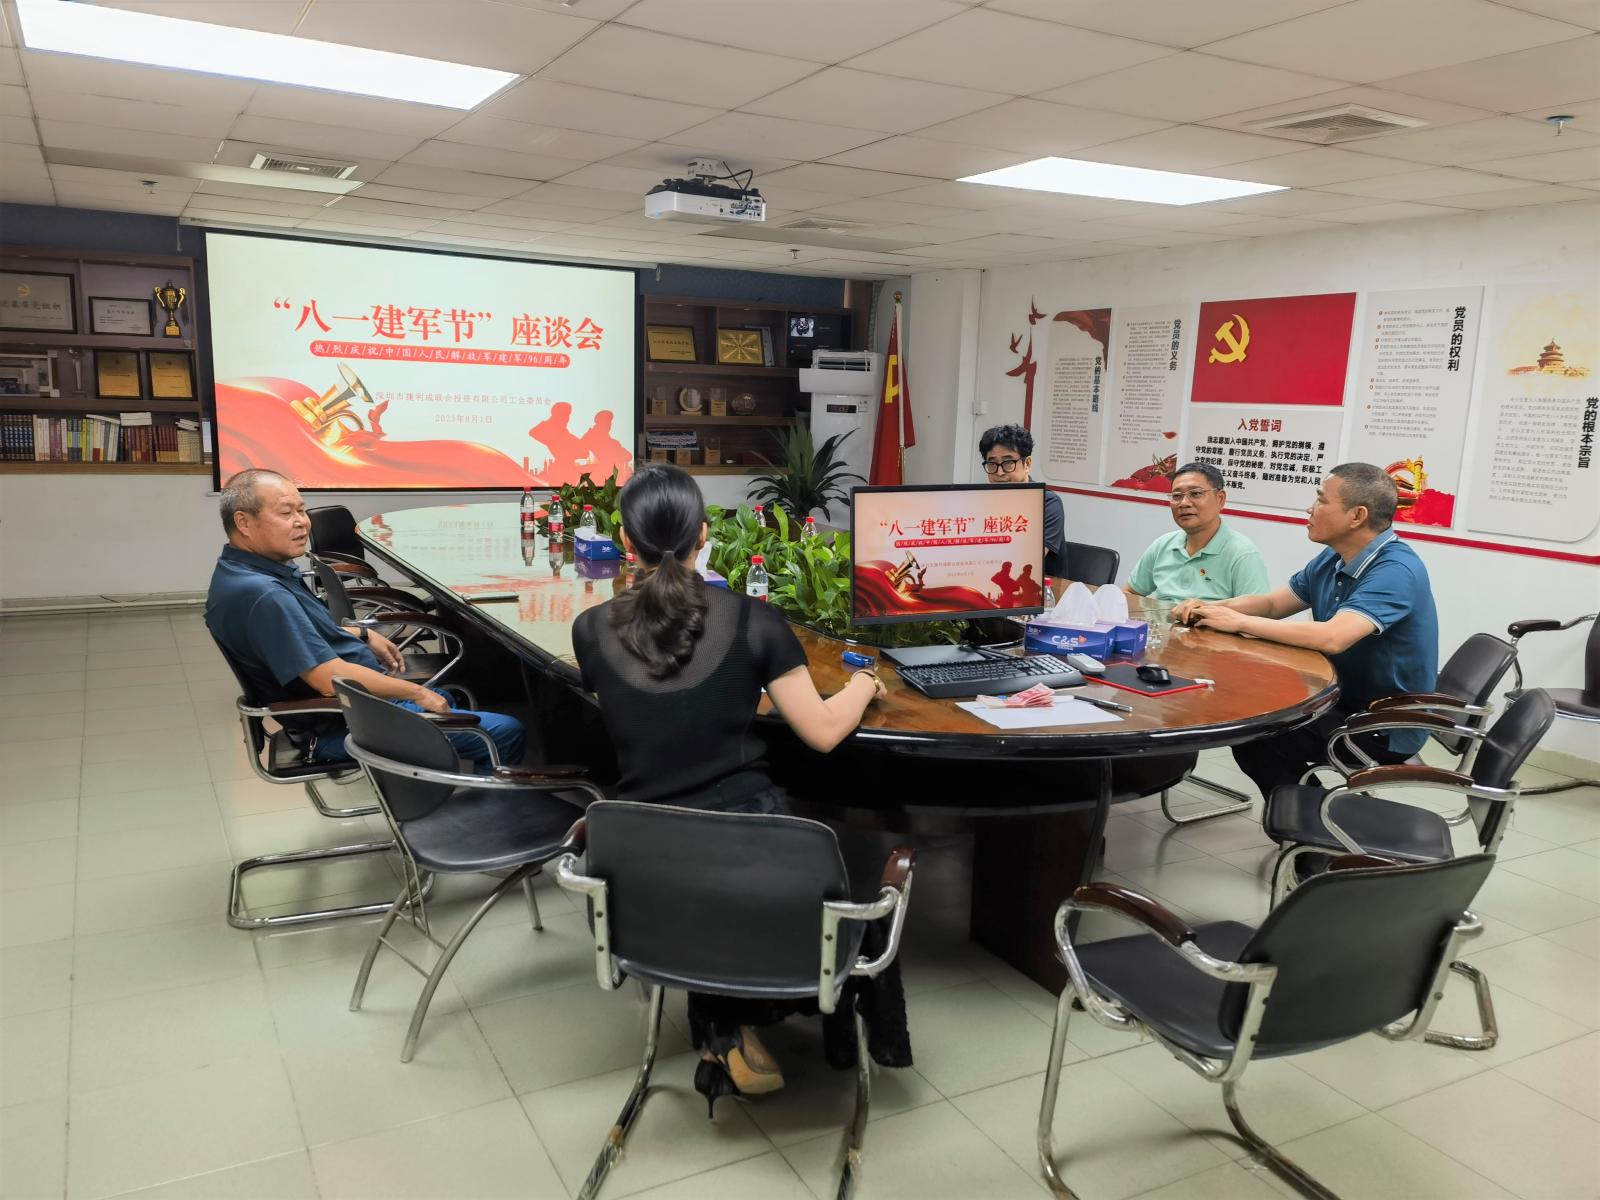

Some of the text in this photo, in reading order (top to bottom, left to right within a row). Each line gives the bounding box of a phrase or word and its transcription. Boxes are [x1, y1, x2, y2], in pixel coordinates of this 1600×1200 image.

[274, 297, 492, 343] “八一建军节”
[510, 313, 604, 350] 座谈会
[1447, 306, 1467, 372] 党员的权利
[1168, 319, 1182, 371] 党员的义务
[1237, 418, 1283, 433] 入党誓词
[1577, 396, 1600, 469] 党的根本宗旨
[1222, 469, 1322, 486] 主义奋斗终身，随时准备为党和人民
[880, 515, 1029, 537] “八一建军节” 座谈会
[1051, 635, 1080, 648] C&S
